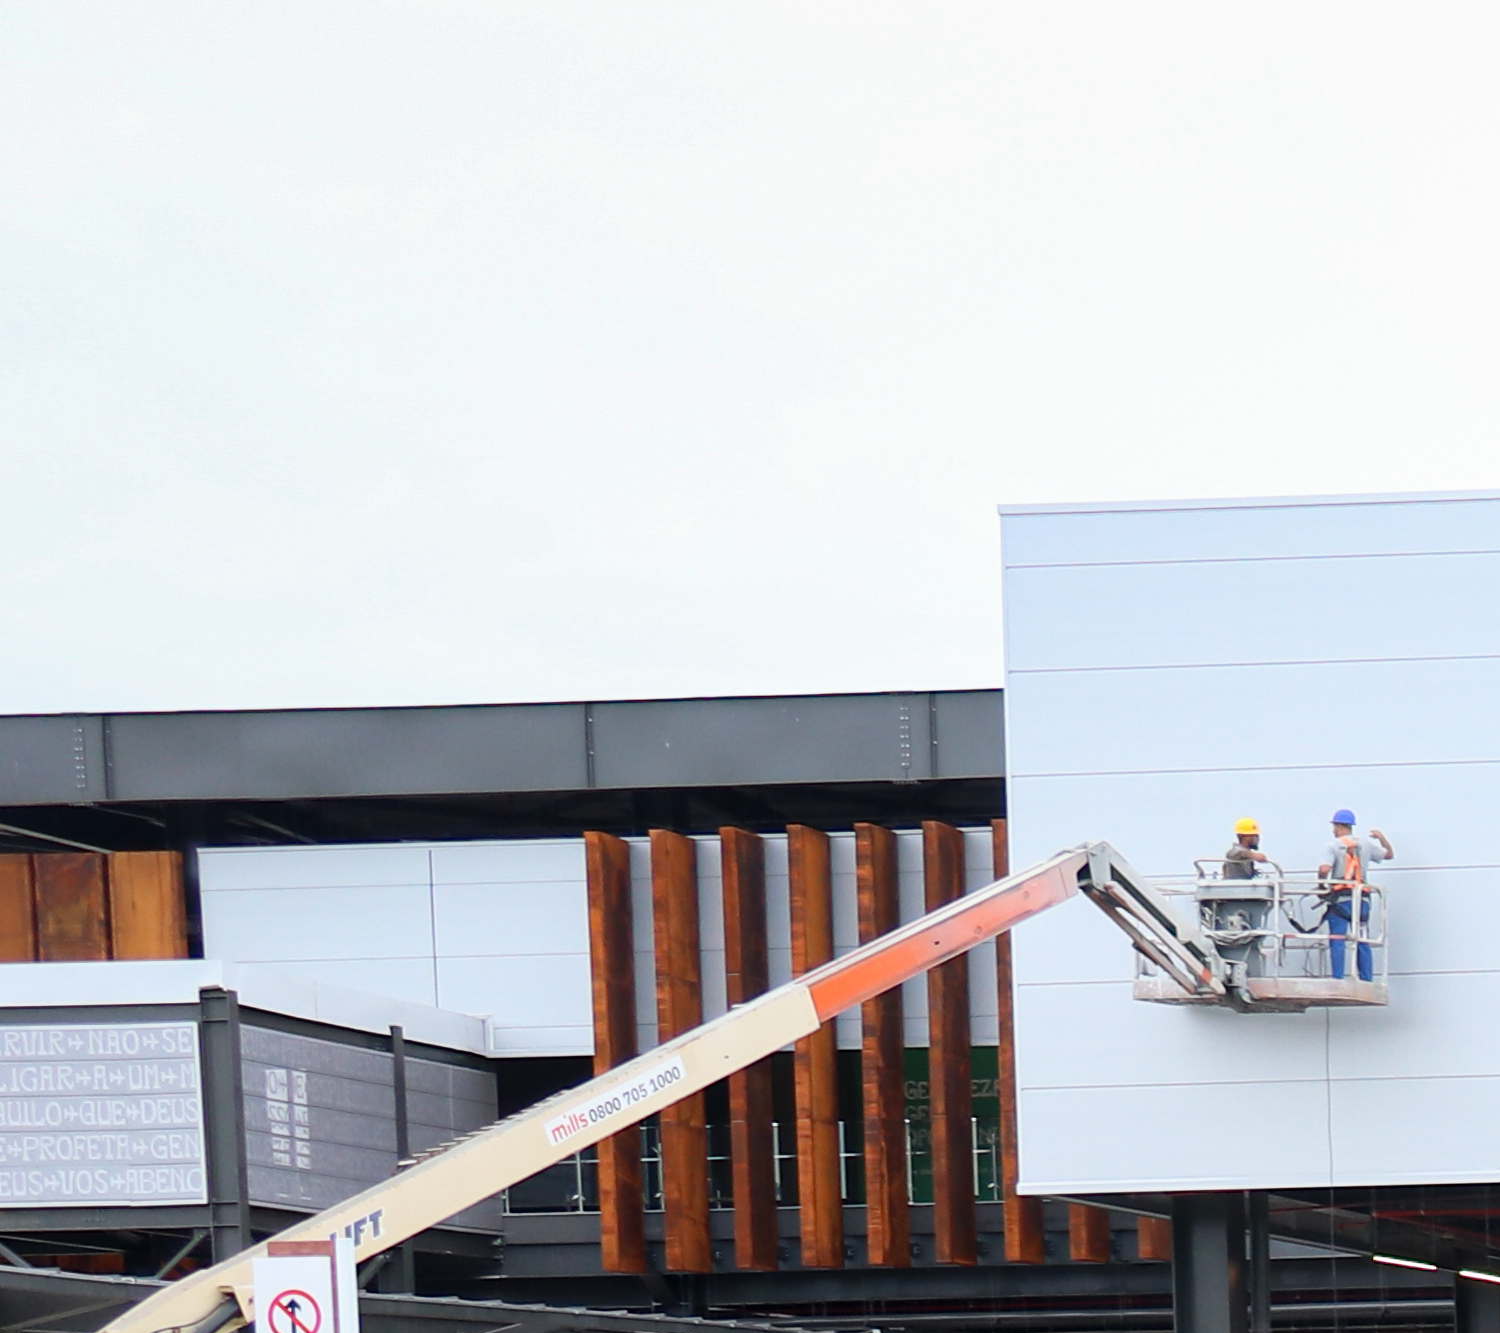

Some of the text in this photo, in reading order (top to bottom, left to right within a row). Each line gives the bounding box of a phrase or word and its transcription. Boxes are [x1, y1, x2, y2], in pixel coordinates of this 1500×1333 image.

[551, 1066, 681, 1143] mills 0800 705 1000
[22, 1134, 133, 1161] PROFETA
